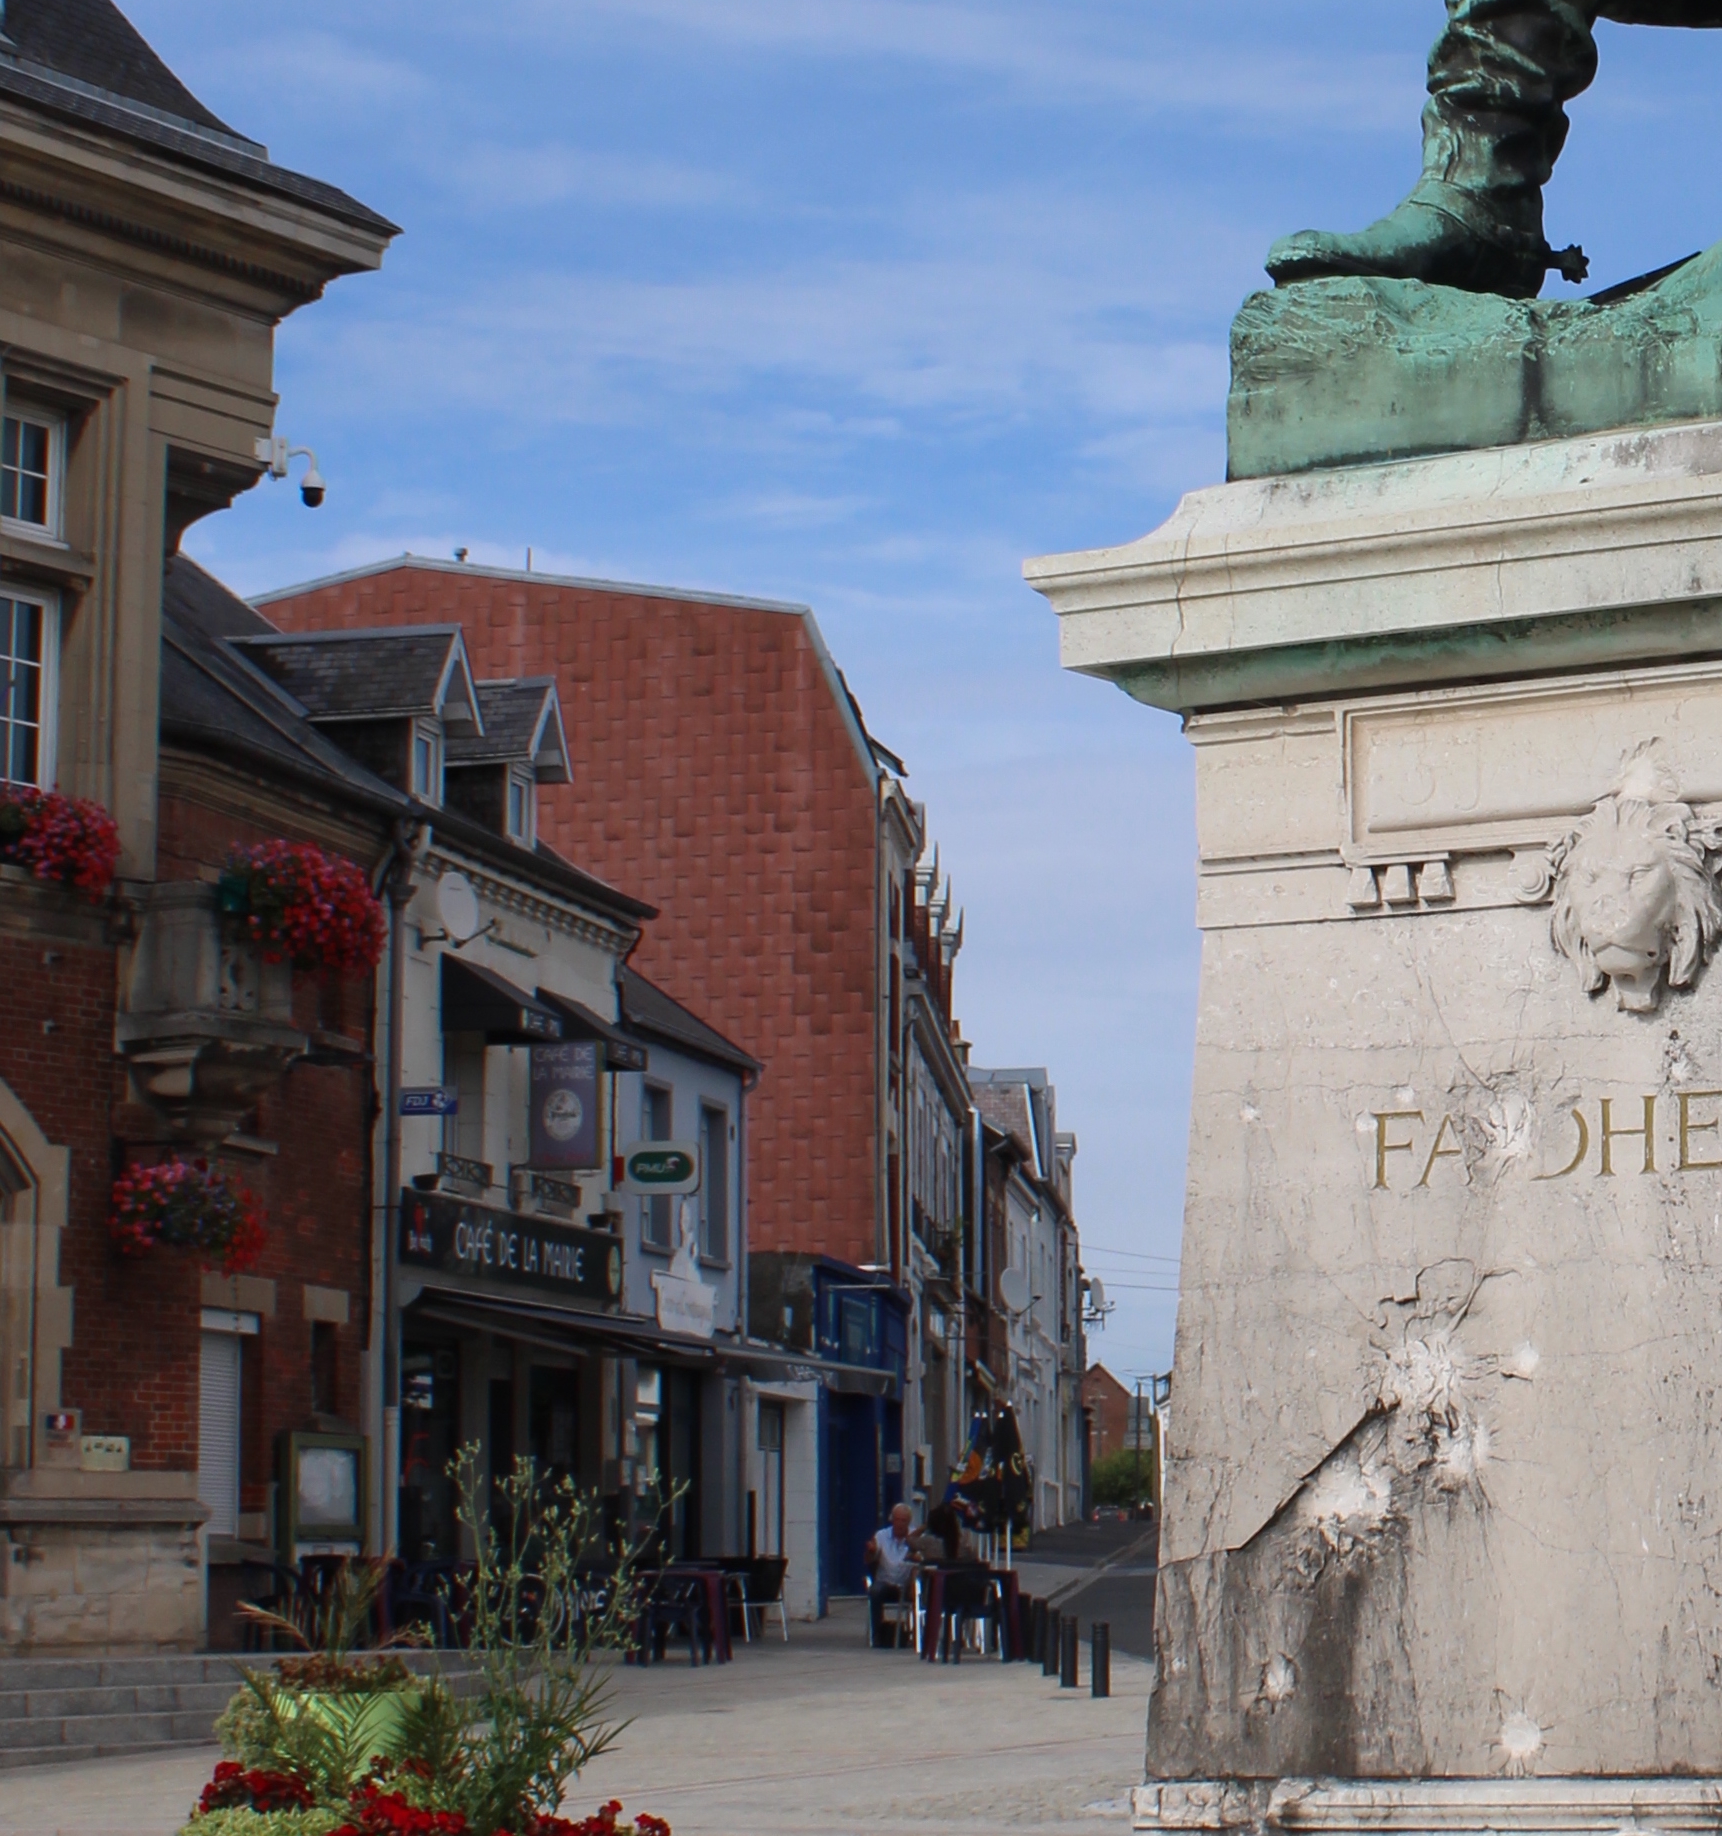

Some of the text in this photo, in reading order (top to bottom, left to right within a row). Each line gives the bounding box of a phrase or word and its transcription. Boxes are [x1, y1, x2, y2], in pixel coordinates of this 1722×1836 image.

[406, 1095, 429, 1107] FDJ
[634, 1162, 664, 1176] PMU
[454, 1220, 493, 1264] CAFÉ
[498, 1231, 518, 1269] DE
[523, 1235, 539, 1273] LA
[542, 1240, 585, 1282] MAIRIE
